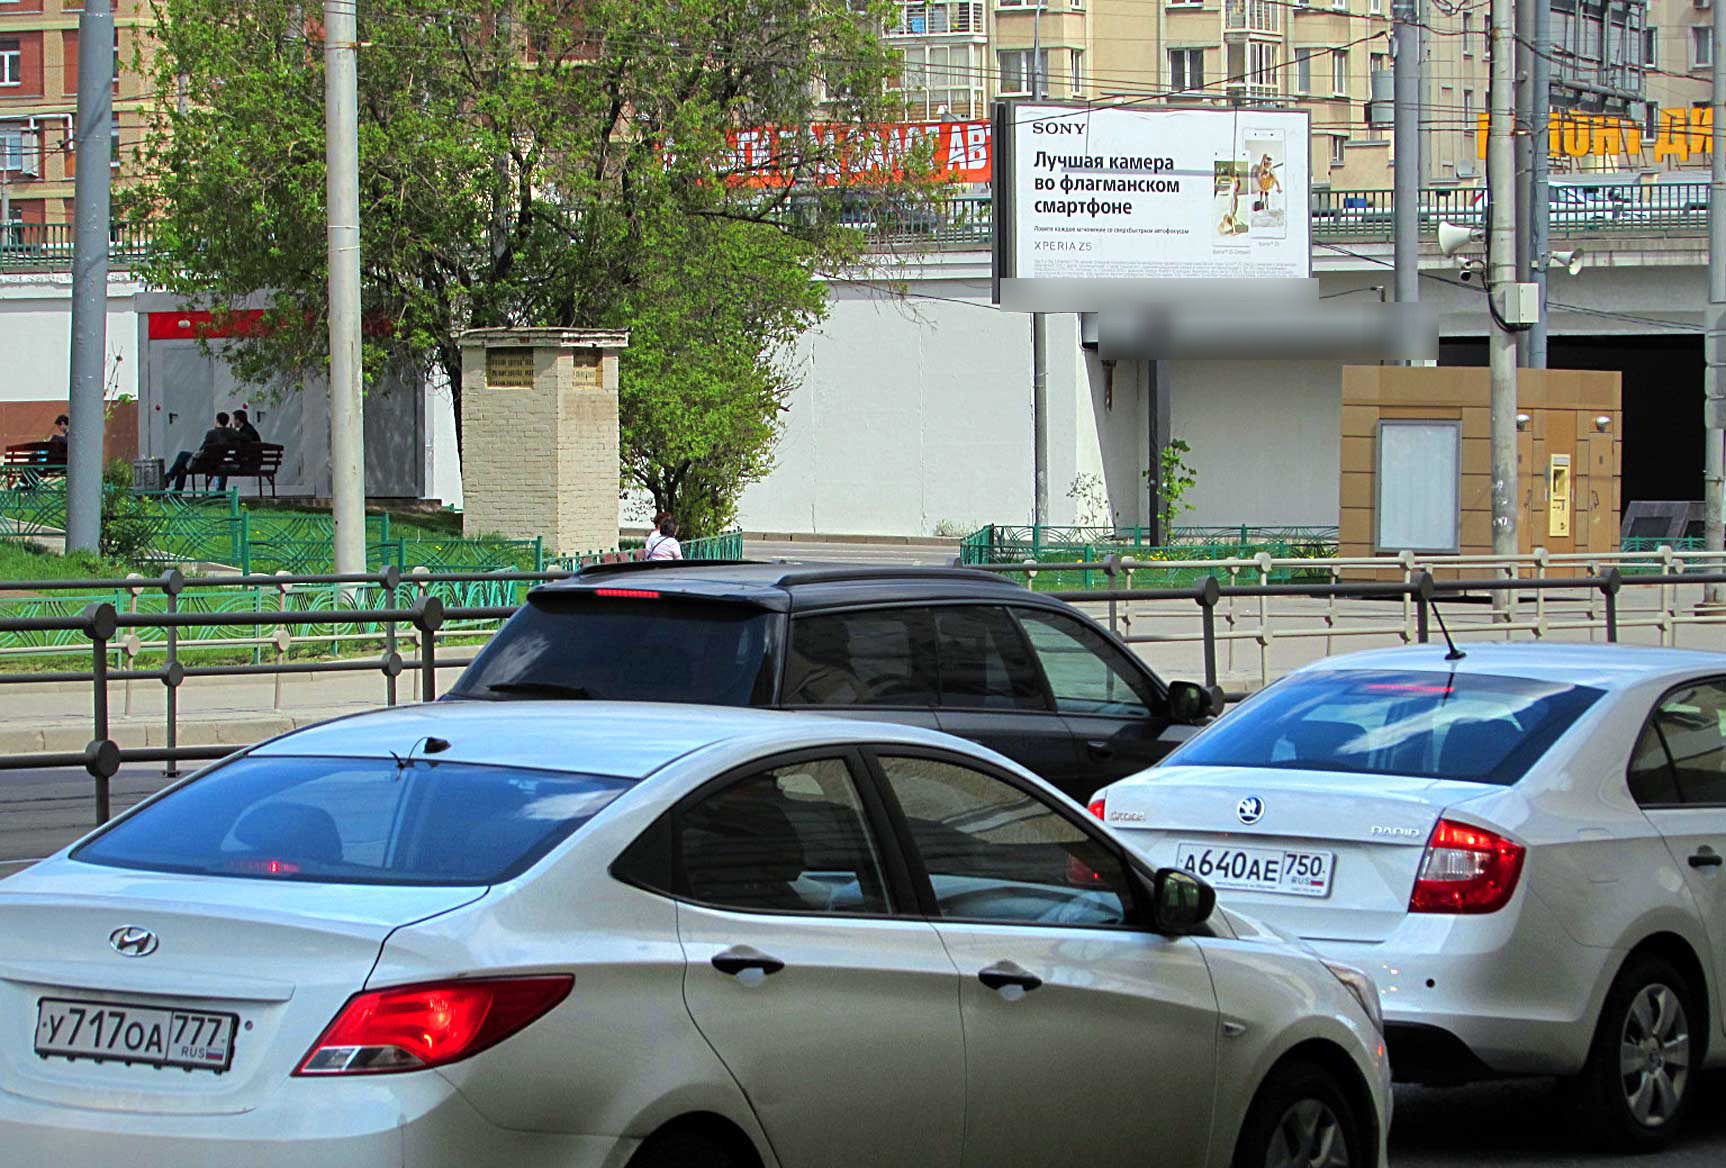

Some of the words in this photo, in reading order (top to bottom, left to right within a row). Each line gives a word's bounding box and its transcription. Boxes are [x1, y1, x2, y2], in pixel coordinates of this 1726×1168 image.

[1032, 122, 1086, 135] SONY
[947, 124, 991, 171] АВ
[1033, 151, 1104, 171] Лучшая
[1109, 155, 1174, 173] камера
[1034, 178, 1055, 191] во
[1060, 175, 1180, 194] флагманском
[1034, 198, 1133, 217] смартфоне
[1034, 241, 1077, 252] XPERIA
[1078, 242, 1093, 252] Z5
[1286, 853, 1322, 877] 750
[1291, 877, 1310, 885] RUS
[174, 1014, 222, 1047] 777
[181, 1046, 205, 1059] RUS
